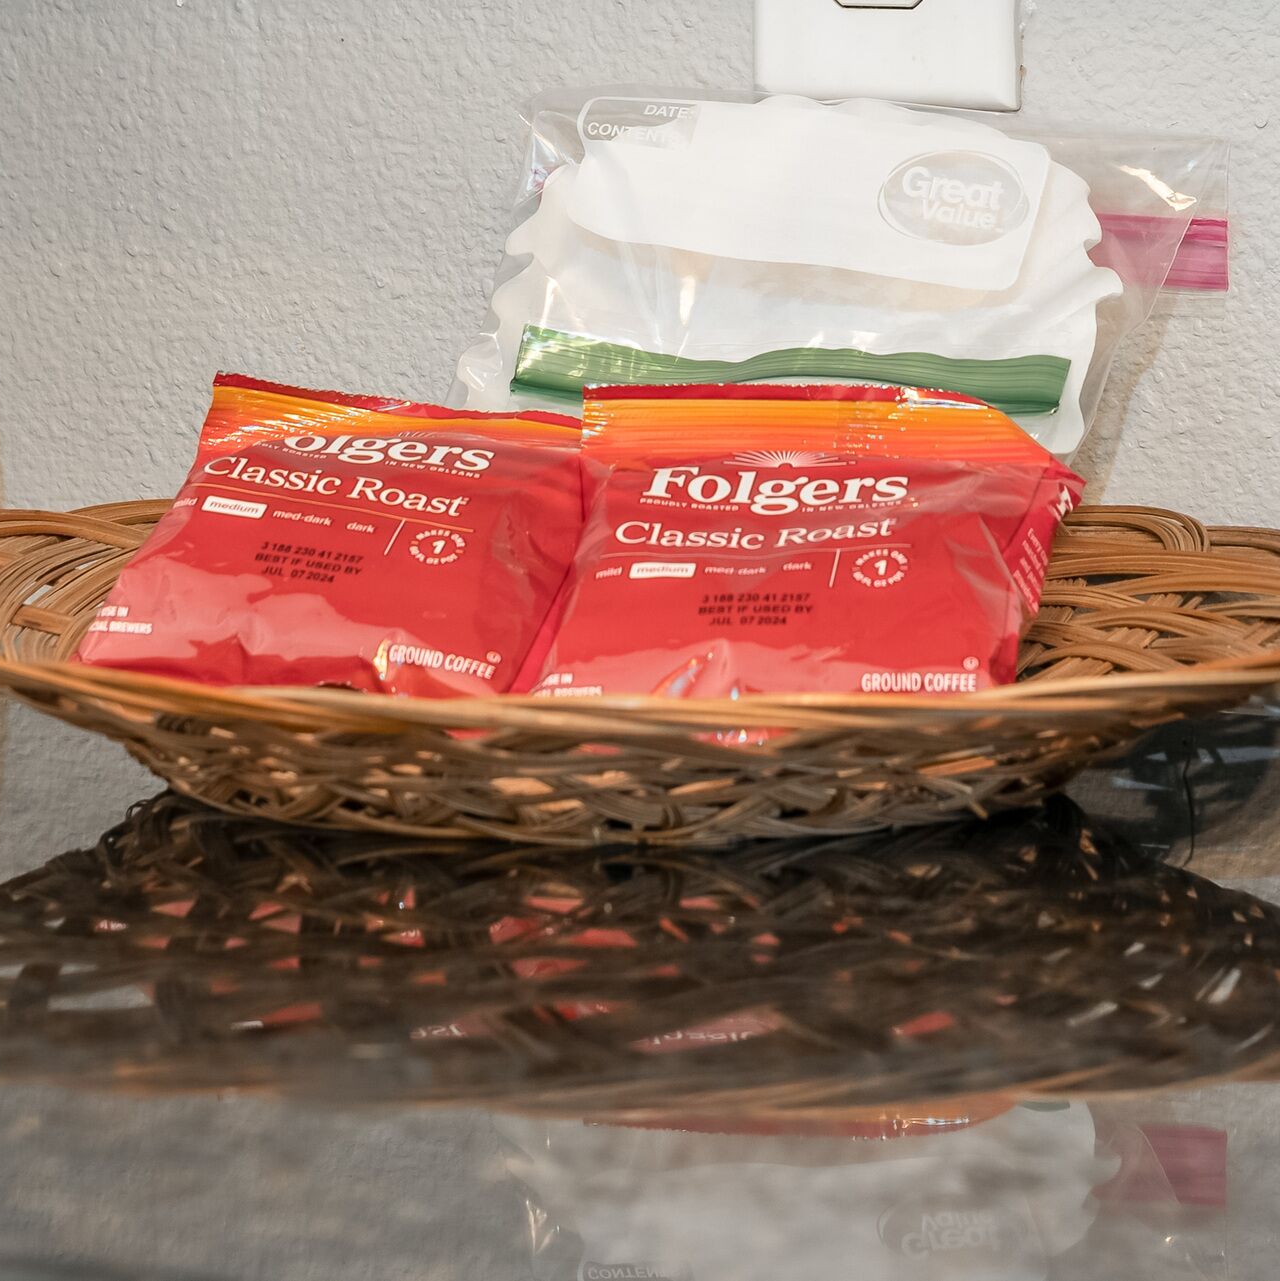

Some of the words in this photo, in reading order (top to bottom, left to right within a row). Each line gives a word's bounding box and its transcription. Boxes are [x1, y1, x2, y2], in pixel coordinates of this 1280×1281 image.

[902, 166, 1004, 210] Great
[922, 196, 996, 229] Value
[284, 433, 495, 472] olgers
[401, 462, 426, 471] NEW
[429, 466, 482, 480] ORLEANS
[204, 456, 342, 496] Classic
[346, 476, 462, 518] Roast
[642, 466, 909, 517] Folgers
[639, 496, 688, 509] PROUDLY
[690, 503, 740, 513] ROASTED
[818, 504, 845, 512] NEW
[209, 500, 260, 515] medium
[272, 508, 333, 527] med-dark
[346, 520, 376, 535] dark
[615, 520, 766, 551] Classic
[774, 518, 894, 549] Roast
[432, 539, 446, 556] 1
[255, 552, 288, 565] BEST
[290, 557, 303, 566] IF
[305, 560, 342, 573] USED
[343, 566, 363, 576] BY
[261, 566, 284, 577] JUL
[290, 569, 306, 579] 07
[306, 571, 336, 583] 2024
[595, 566, 623, 579] mild
[636, 566, 690, 574] medium
[782, 561, 813, 572] dark
[874, 559, 888, 576] 1
[698, 605, 732, 616] BEST
[752, 605, 791, 615] USED
[794, 605, 814, 615] BY
[708, 616, 732, 626] JUL
[739, 616, 755, 626] 07
[757, 616, 787, 626] 2024
[389, 643, 444, 669] GROUND
[444, 652, 497, 681] COFFEE
[861, 671, 922, 693] GROUND
[923, 672, 977, 693] COFFEE
